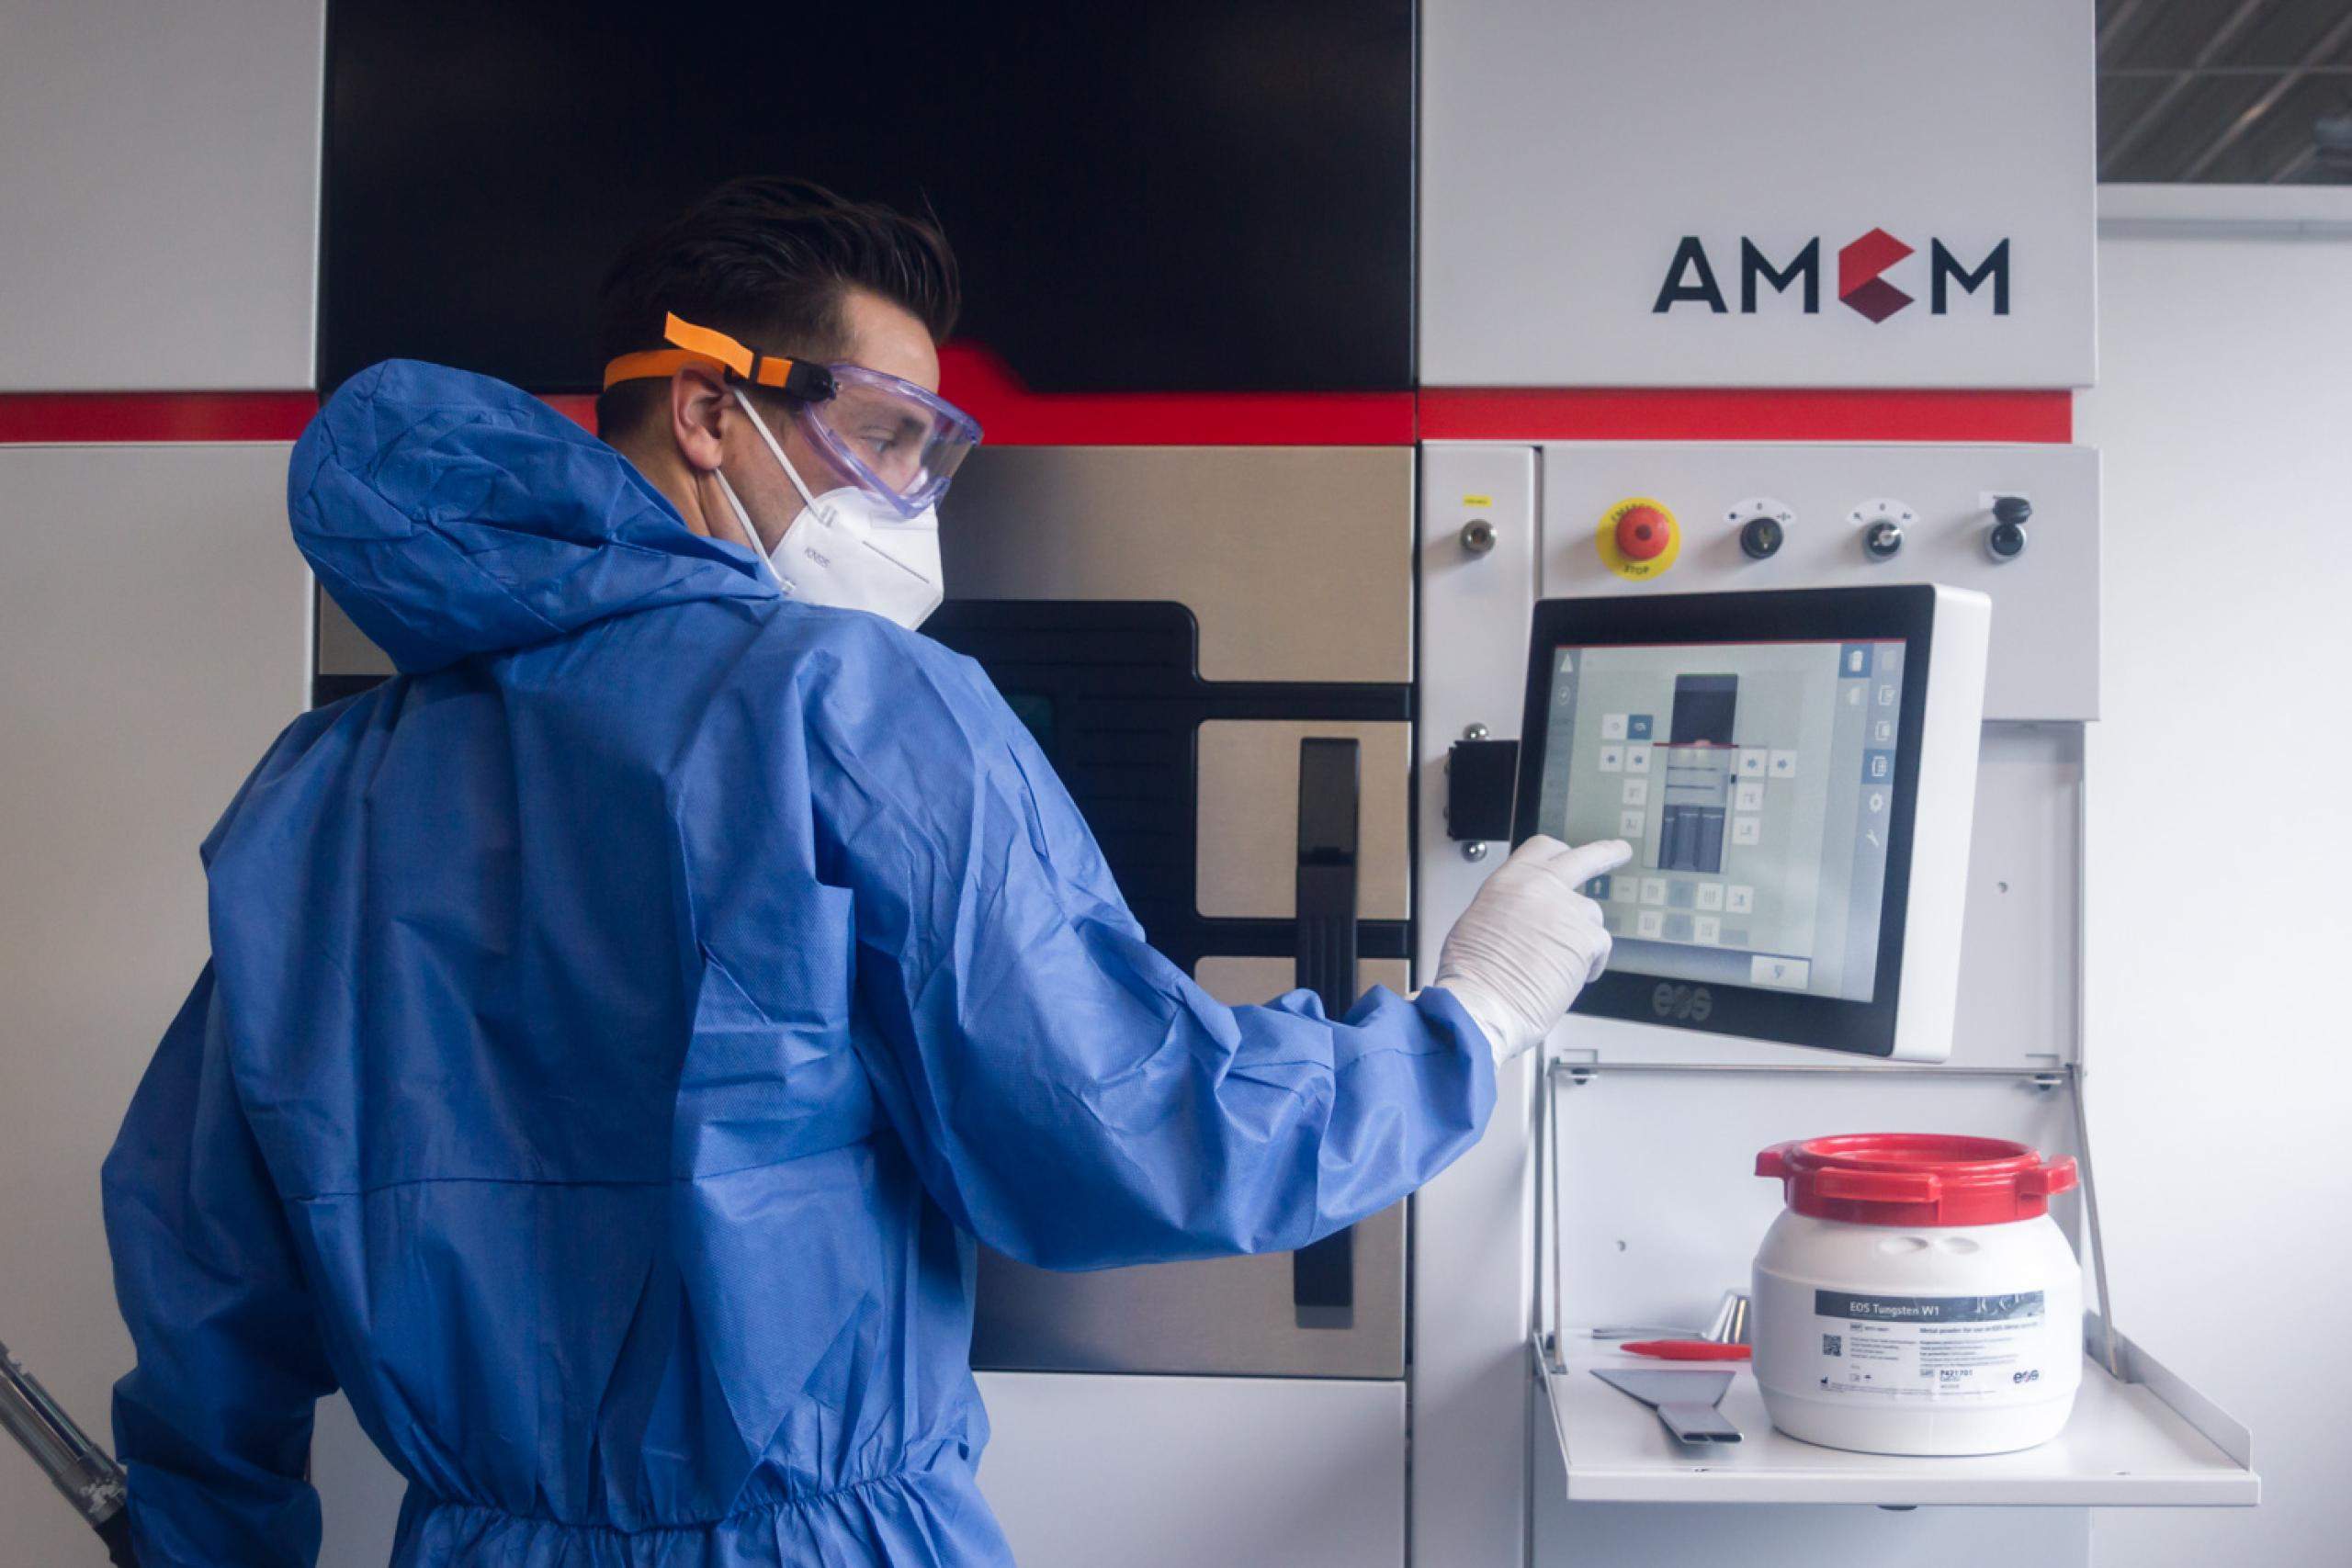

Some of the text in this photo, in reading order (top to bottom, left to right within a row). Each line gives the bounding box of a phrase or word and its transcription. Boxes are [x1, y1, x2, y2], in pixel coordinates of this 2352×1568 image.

[1651, 226, 2010, 324] AMCM
[1623, 564, 1650, 575] STOP
[1849, 1301, 1940, 1318] EOS Tungsten W1
